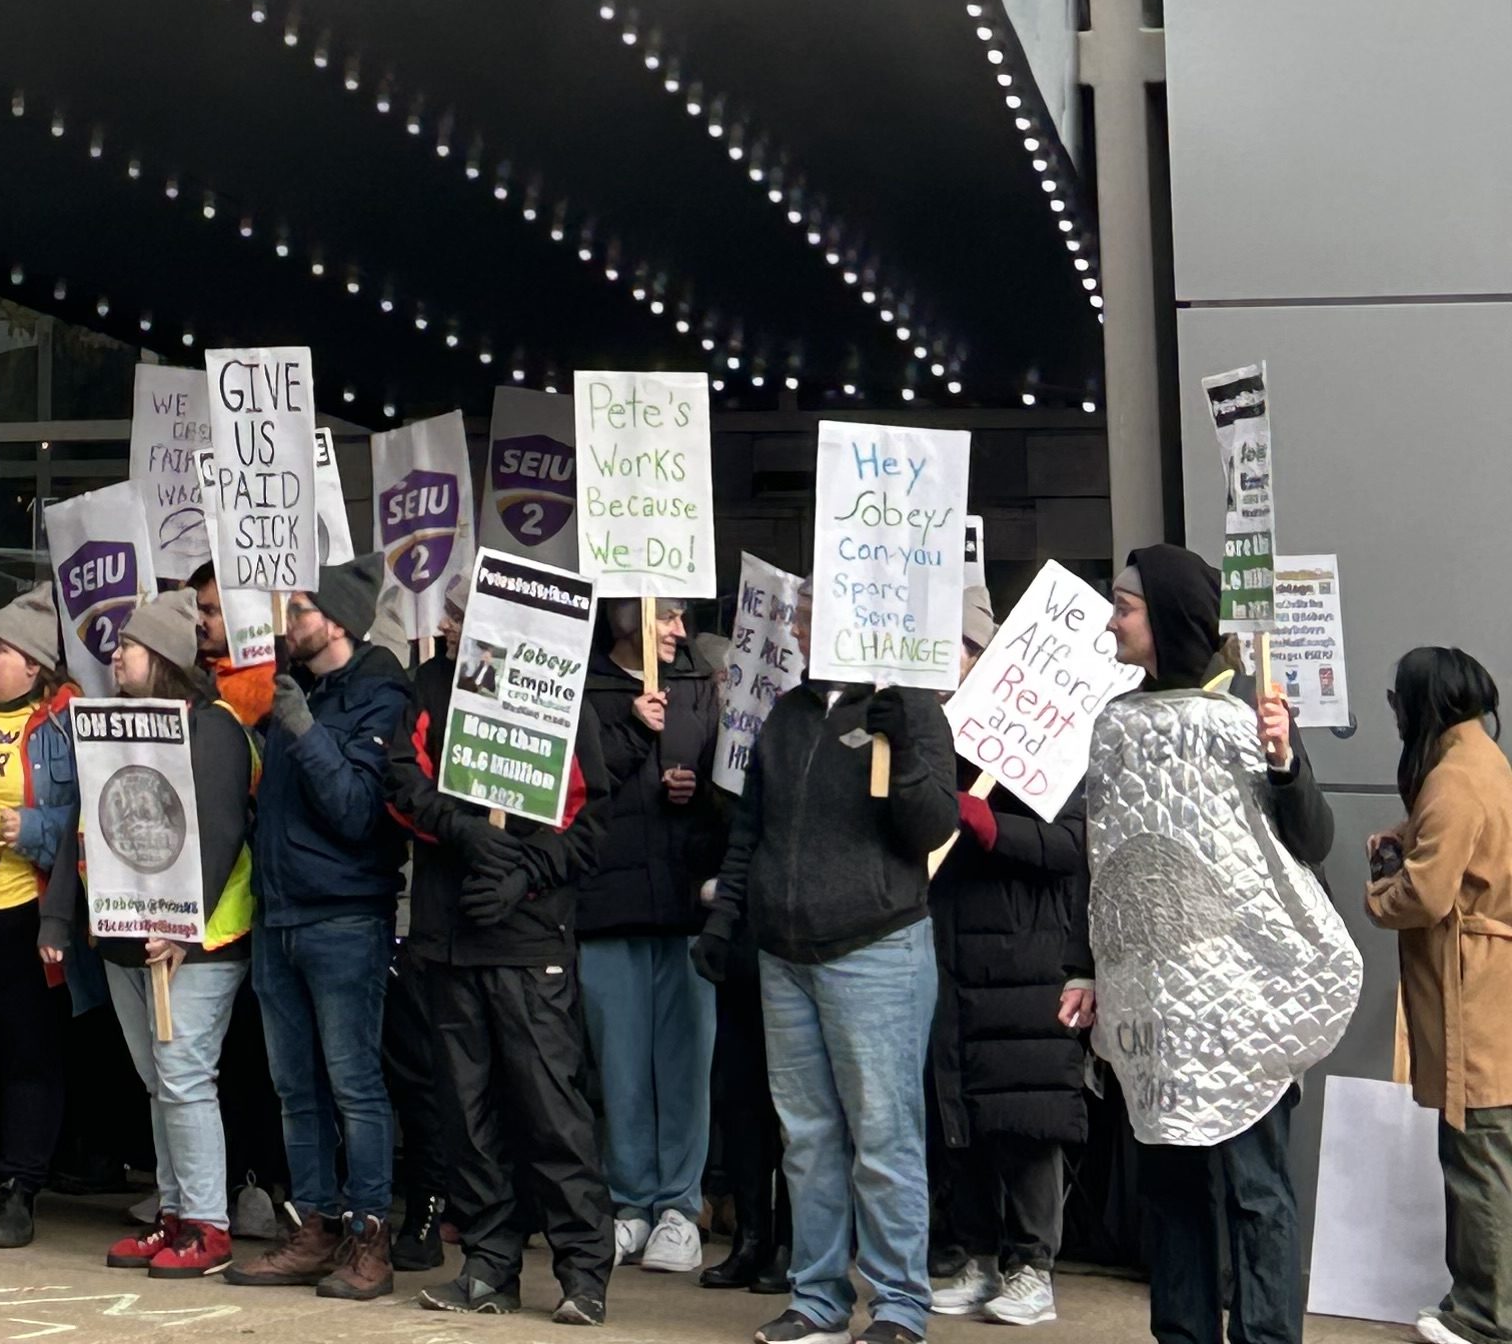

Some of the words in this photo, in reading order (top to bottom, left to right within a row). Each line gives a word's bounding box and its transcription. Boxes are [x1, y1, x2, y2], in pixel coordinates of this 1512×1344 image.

[152, 391, 189, 417] WE
[219, 360, 302, 413] GIVE
[589, 382, 692, 430] Pete's
[234, 420, 276, 468] US
[498, 448, 575, 483] SEIU
[851, 441, 927, 497] Hey
[218, 468, 301, 511] PAID
[387, 483, 450, 526] SEIU
[587, 486, 699, 519] Because
[235, 514, 300, 550] SICK
[521, 502, 543, 537] 2
[834, 490, 954, 547] Sobeys
[410, 545, 431, 583] 2
[586, 530, 632, 568] We
[647, 534, 695, 573] Do!
[839, 536, 889, 562] Can
[68, 550, 128, 598] SEIU
[237, 553, 297, 586] DAYS
[833, 572, 910, 605] Spare
[853, 604, 916, 633] Some
[1044, 580, 1086, 633] We
[94, 615, 117, 653] 2
[834, 627, 953, 666] CHANGE
[512, 642, 582, 678] Sobeys
[1005, 621, 1115, 715] Afford
[508, 668, 576, 702] Empire
[992, 663, 1076, 739] Rent
[76, 712, 107, 738] ON
[109, 712, 183, 740] STRIKE
[463, 713, 508, 745] More
[509, 728, 553, 758] than
[987, 706, 1048, 757] and
[451, 743, 489, 772] $8.6
[957, 717, 1049, 797] FOOD
[488, 784, 526, 812] 2022
